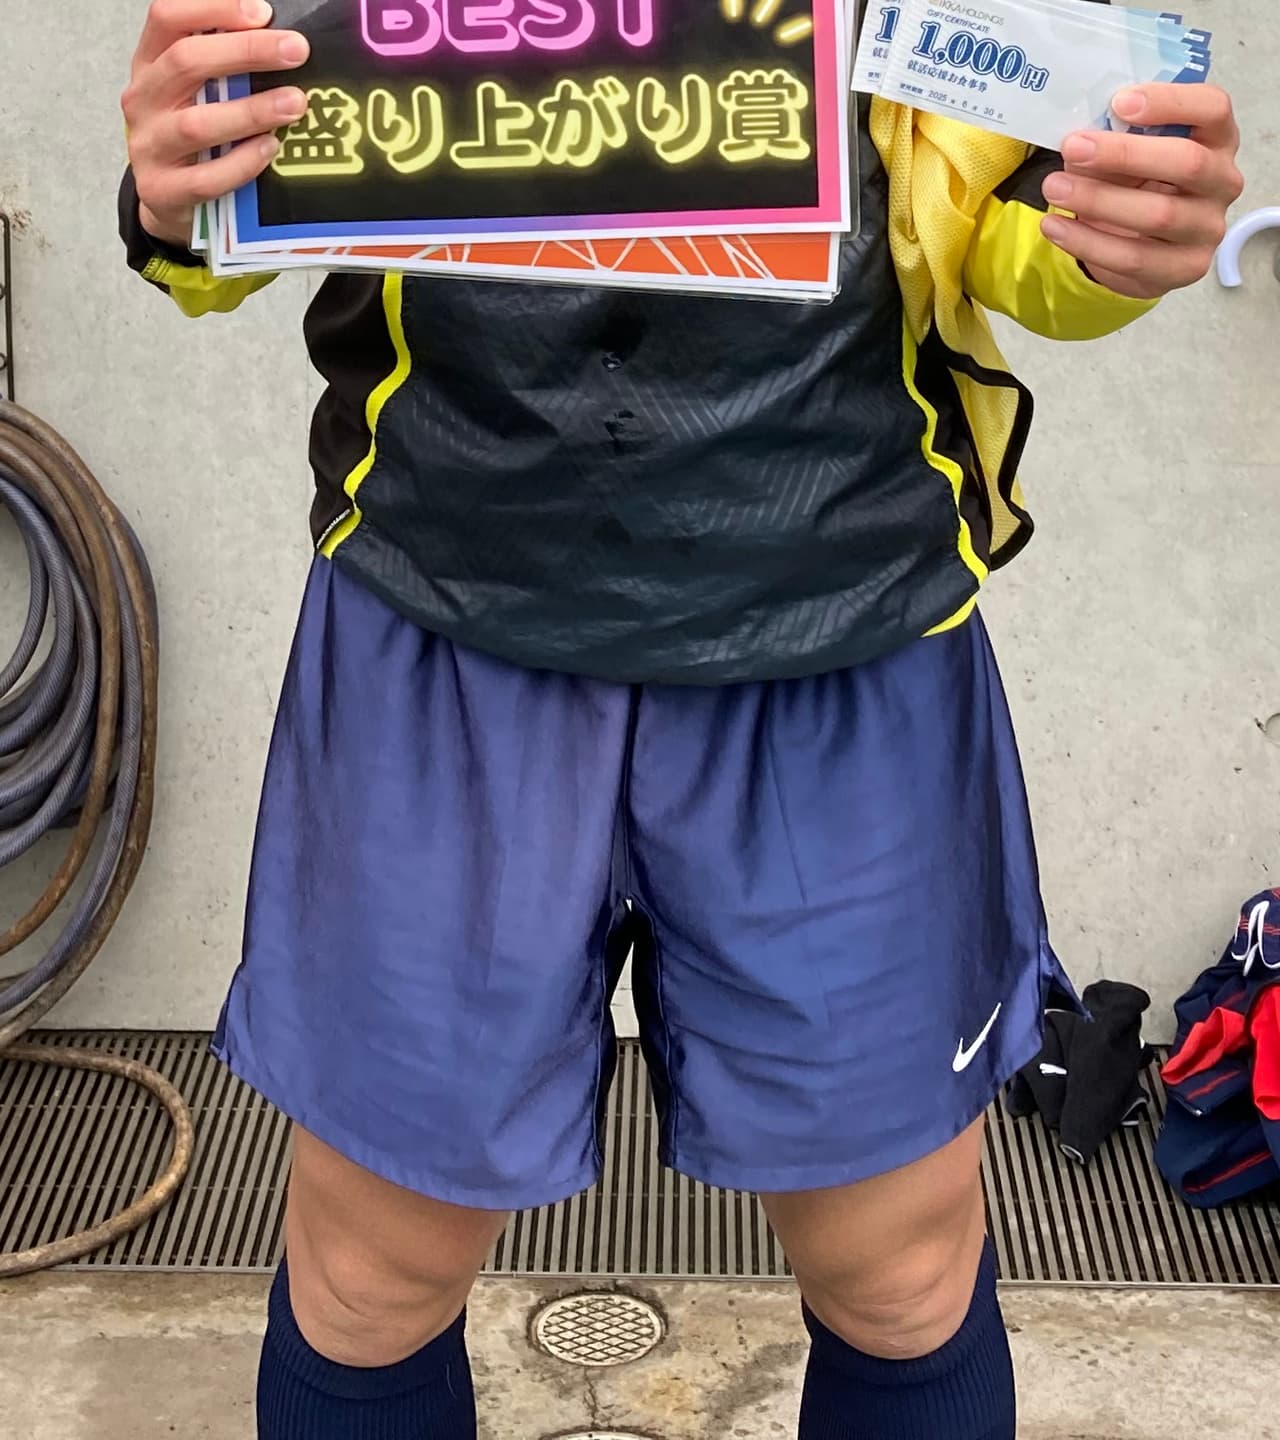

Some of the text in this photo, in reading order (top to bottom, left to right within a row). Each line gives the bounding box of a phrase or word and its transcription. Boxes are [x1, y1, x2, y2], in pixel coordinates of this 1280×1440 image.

[945, 14, 991, 34] CERTIFICATE
[271, 68, 811, 177] 盛り上がり賞
